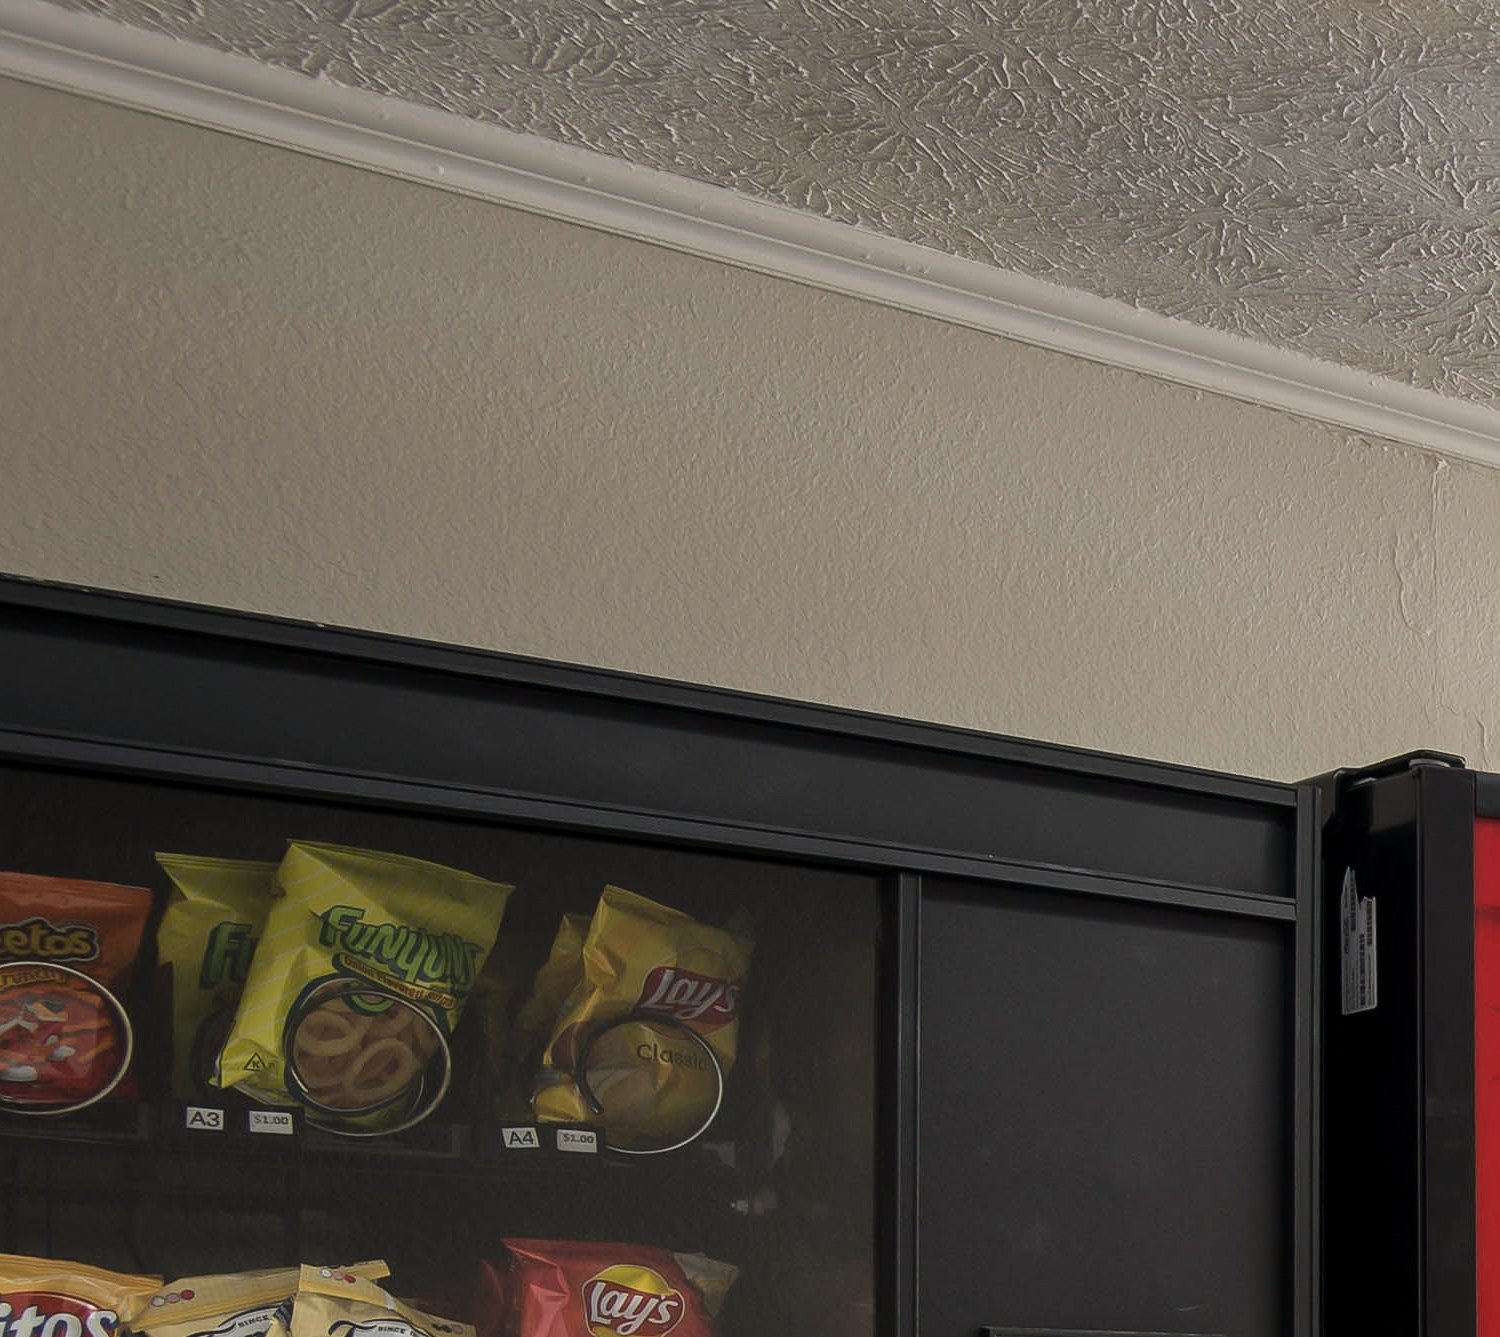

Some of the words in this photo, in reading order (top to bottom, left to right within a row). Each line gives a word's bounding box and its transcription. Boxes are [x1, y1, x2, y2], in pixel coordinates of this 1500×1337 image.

[640, 968, 739, 1018] Lay's
[190, 1111, 220, 1127] A3
[253, 1114, 289, 1127] $1.00
[508, 1131, 534, 1145] A4
[563, 1133, 594, 1143] $1.00
[590, 1282, 679, 1335] Lay's
[238, 1314, 268, 1328] SINCE
